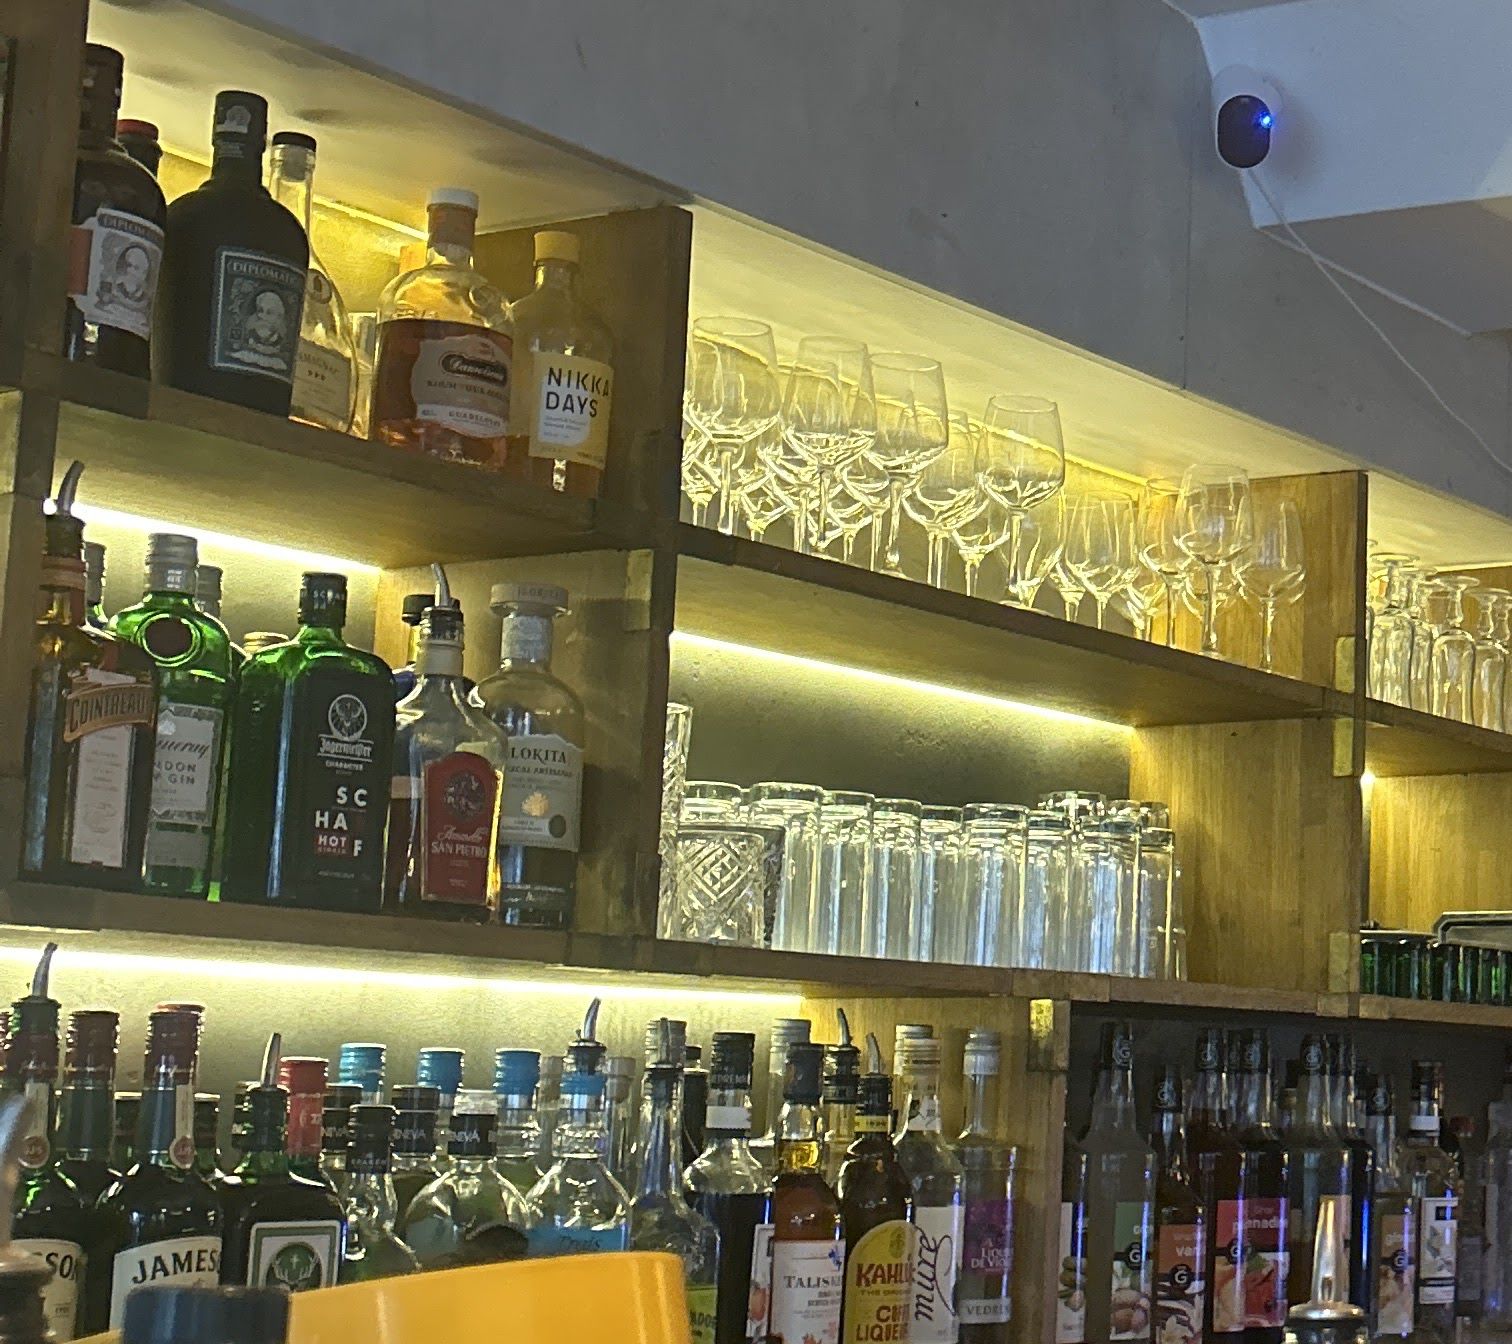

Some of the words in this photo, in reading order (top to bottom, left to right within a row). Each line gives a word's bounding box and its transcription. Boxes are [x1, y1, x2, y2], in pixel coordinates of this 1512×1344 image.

[547, 367, 609, 397] NIKKA
[546, 391, 599, 418] DAYS
[510, 747, 567, 765] LOKITA
[318, 835, 347, 847] HOT
[431, 842, 453, 854] SAN
